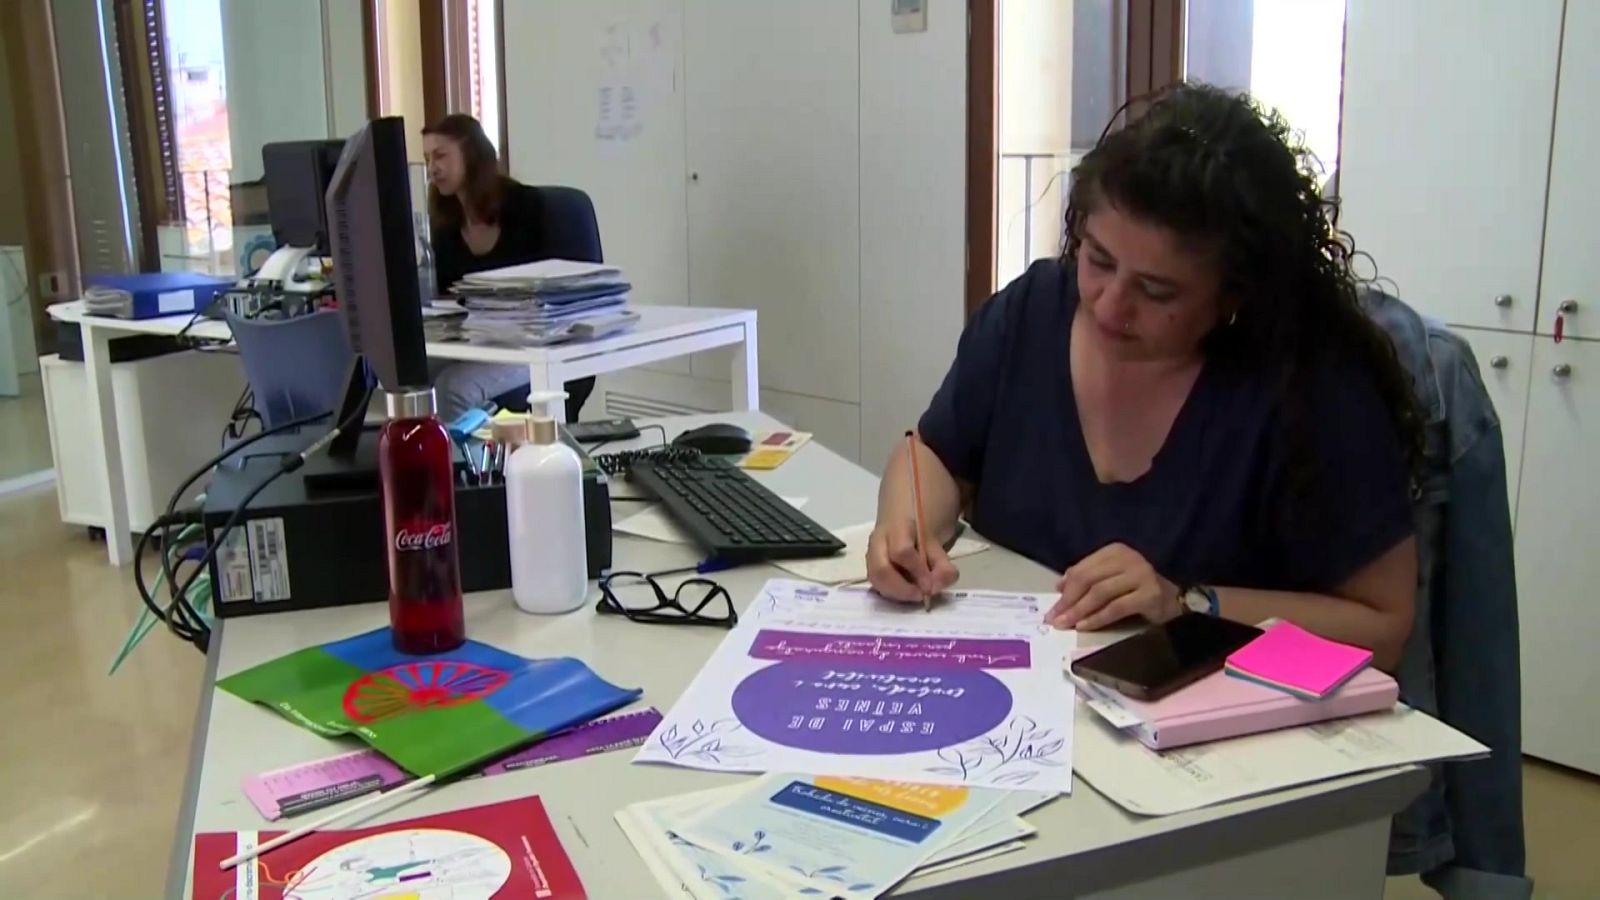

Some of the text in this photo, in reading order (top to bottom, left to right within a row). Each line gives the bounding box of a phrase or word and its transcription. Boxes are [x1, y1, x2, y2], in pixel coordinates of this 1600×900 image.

[822, 670, 942, 684] creativitat
[812, 682, 861, 690] cura
[787, 715, 935, 735] ESPAI DE
